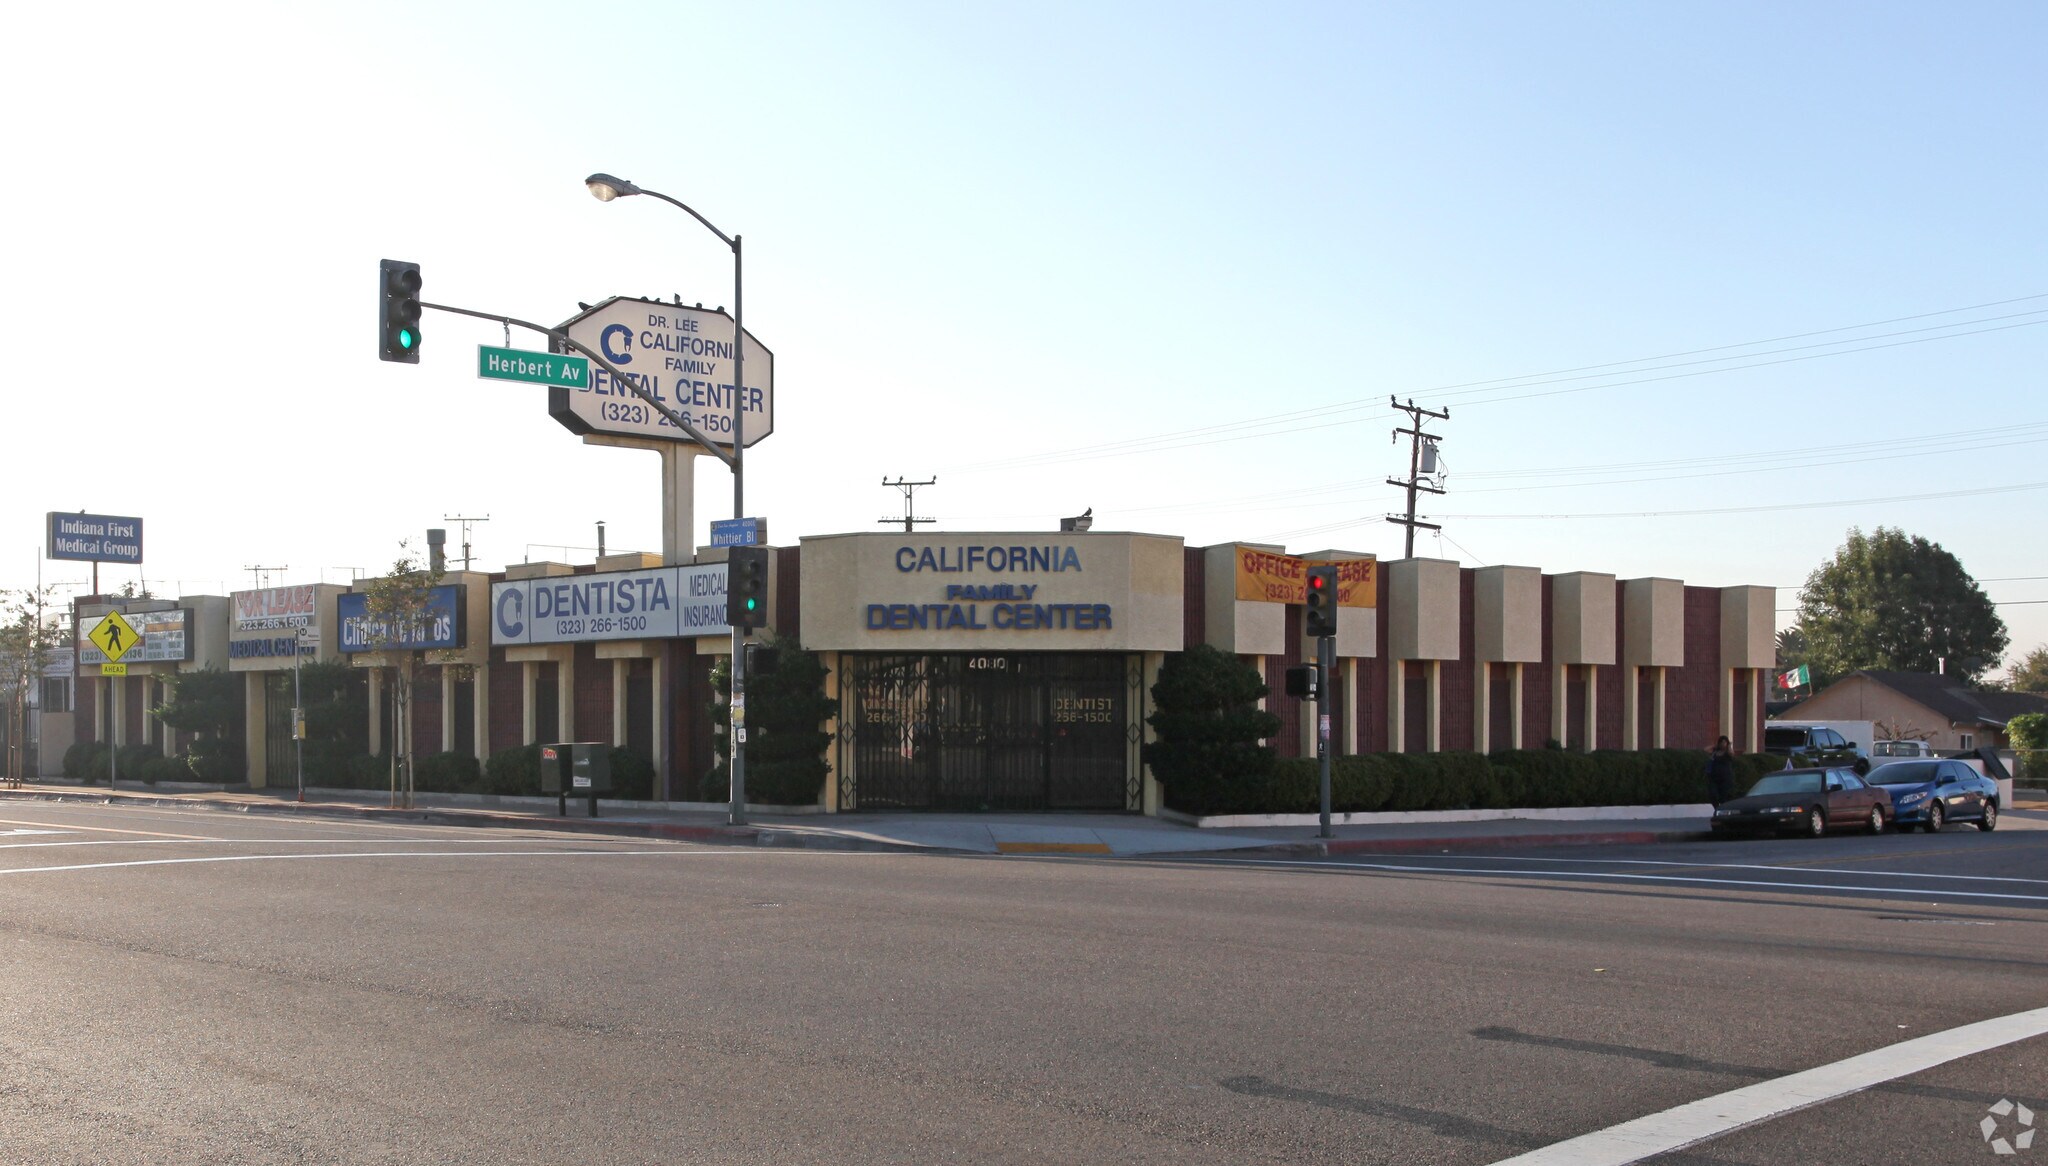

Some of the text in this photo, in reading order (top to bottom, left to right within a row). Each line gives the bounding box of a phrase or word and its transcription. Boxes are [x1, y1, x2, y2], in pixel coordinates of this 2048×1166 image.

[648, 314, 699, 333] DR. LEE
[640, 331, 745, 362] CALIFORNI
[489, 354, 580, 380] Herbert Av
[665, 357, 716, 376] FAMILY
[601, 401, 735, 433] (323) 26-150
[61, 519, 134, 538] Indiana First
[713, 533, 742, 545] Whittier
[103, 540, 139, 559] Group
[895, 546, 1082, 573] CALIFORNIA
[1243, 552, 1371, 583] OFFICE EASE
[689, 573, 728, 597] MEDICAL
[945, 584, 1038, 601] FAMILY
[1266, 583, 1294, 603] (323)
[268, 586, 314, 615] LEASE
[535, 577, 670, 619] DENTISTA
[240, 616, 308, 631] 323.266.1500
[556, 615, 647, 636] (323) 266-1500
[684, 603, 727, 627] INSURANC
[866, 603, 1113, 630] DENTAL CENTER
[229, 637, 315, 658] MEDICAL CEN
[1054, 698, 1115, 710] DENTIST
